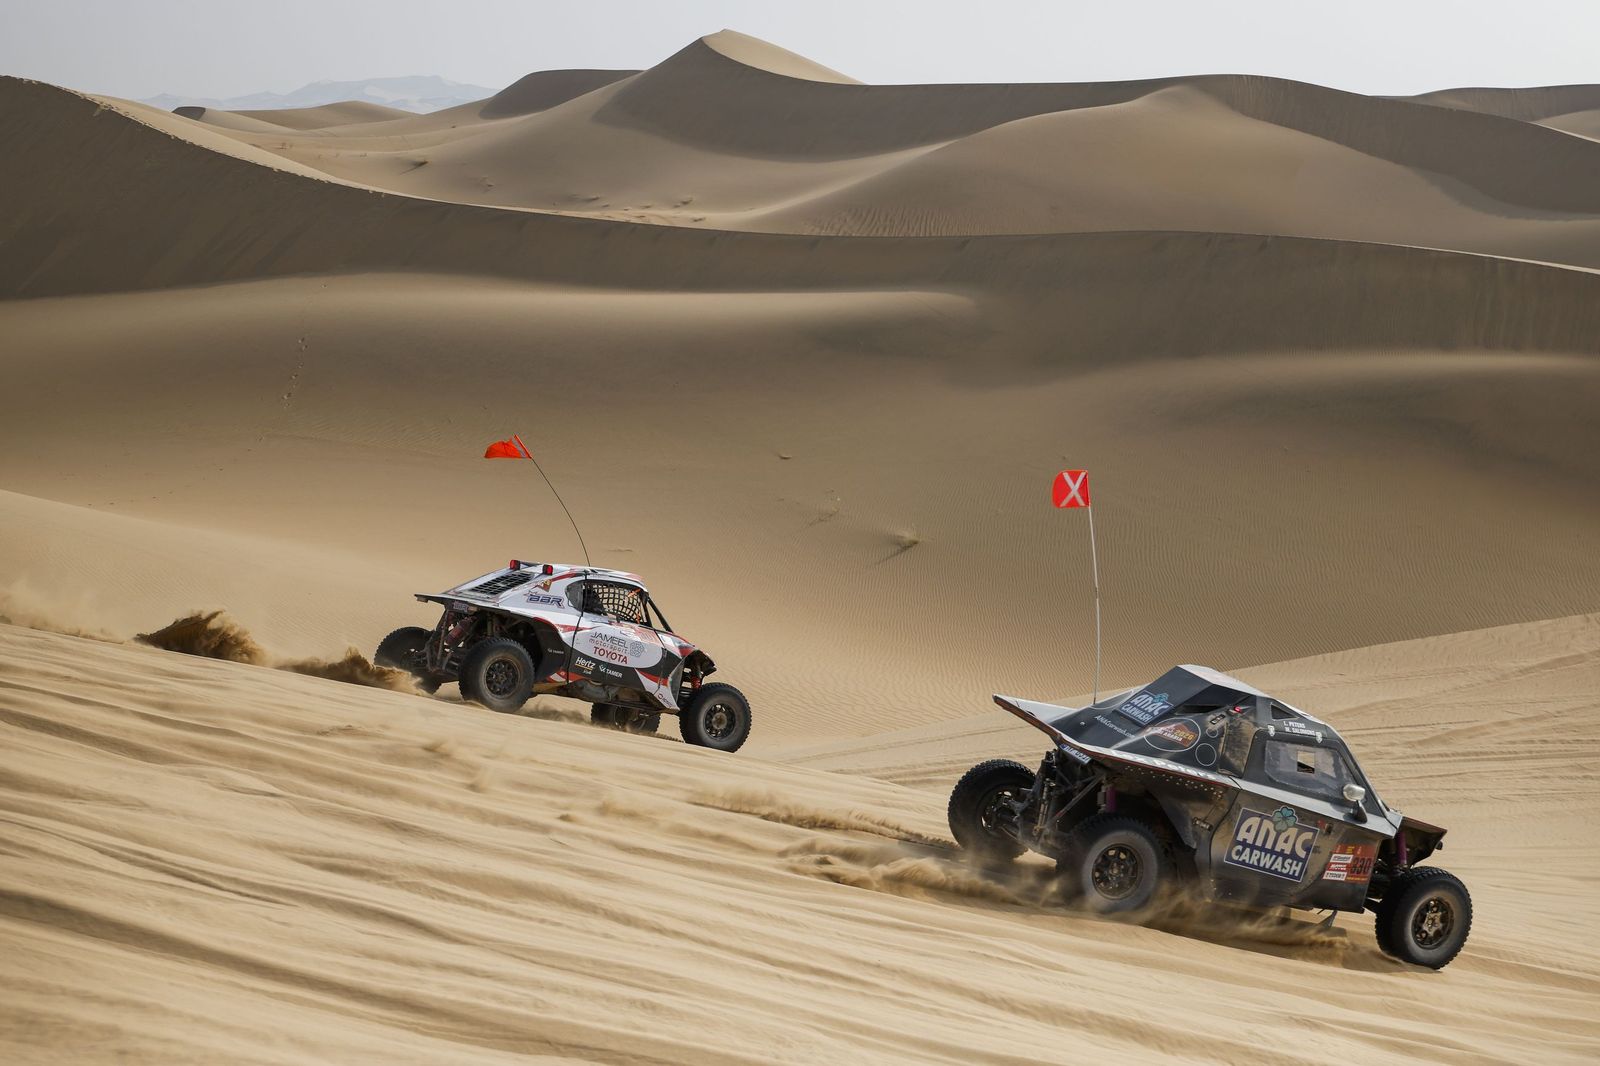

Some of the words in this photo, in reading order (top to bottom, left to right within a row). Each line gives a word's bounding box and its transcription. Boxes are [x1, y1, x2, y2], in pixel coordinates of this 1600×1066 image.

[590, 632, 629, 649] JAMEEL
[575, 656, 596, 669] Hertz
[593, 646, 628, 664] TOYOTA
[606, 668, 623, 678] TAMER
[1121, 703, 1153, 723] CARWASH
[1130, 694, 1169, 715] ANAC
[1236, 816, 1314, 859] ANAC
[1231, 844, 1303, 877] CARWASH
